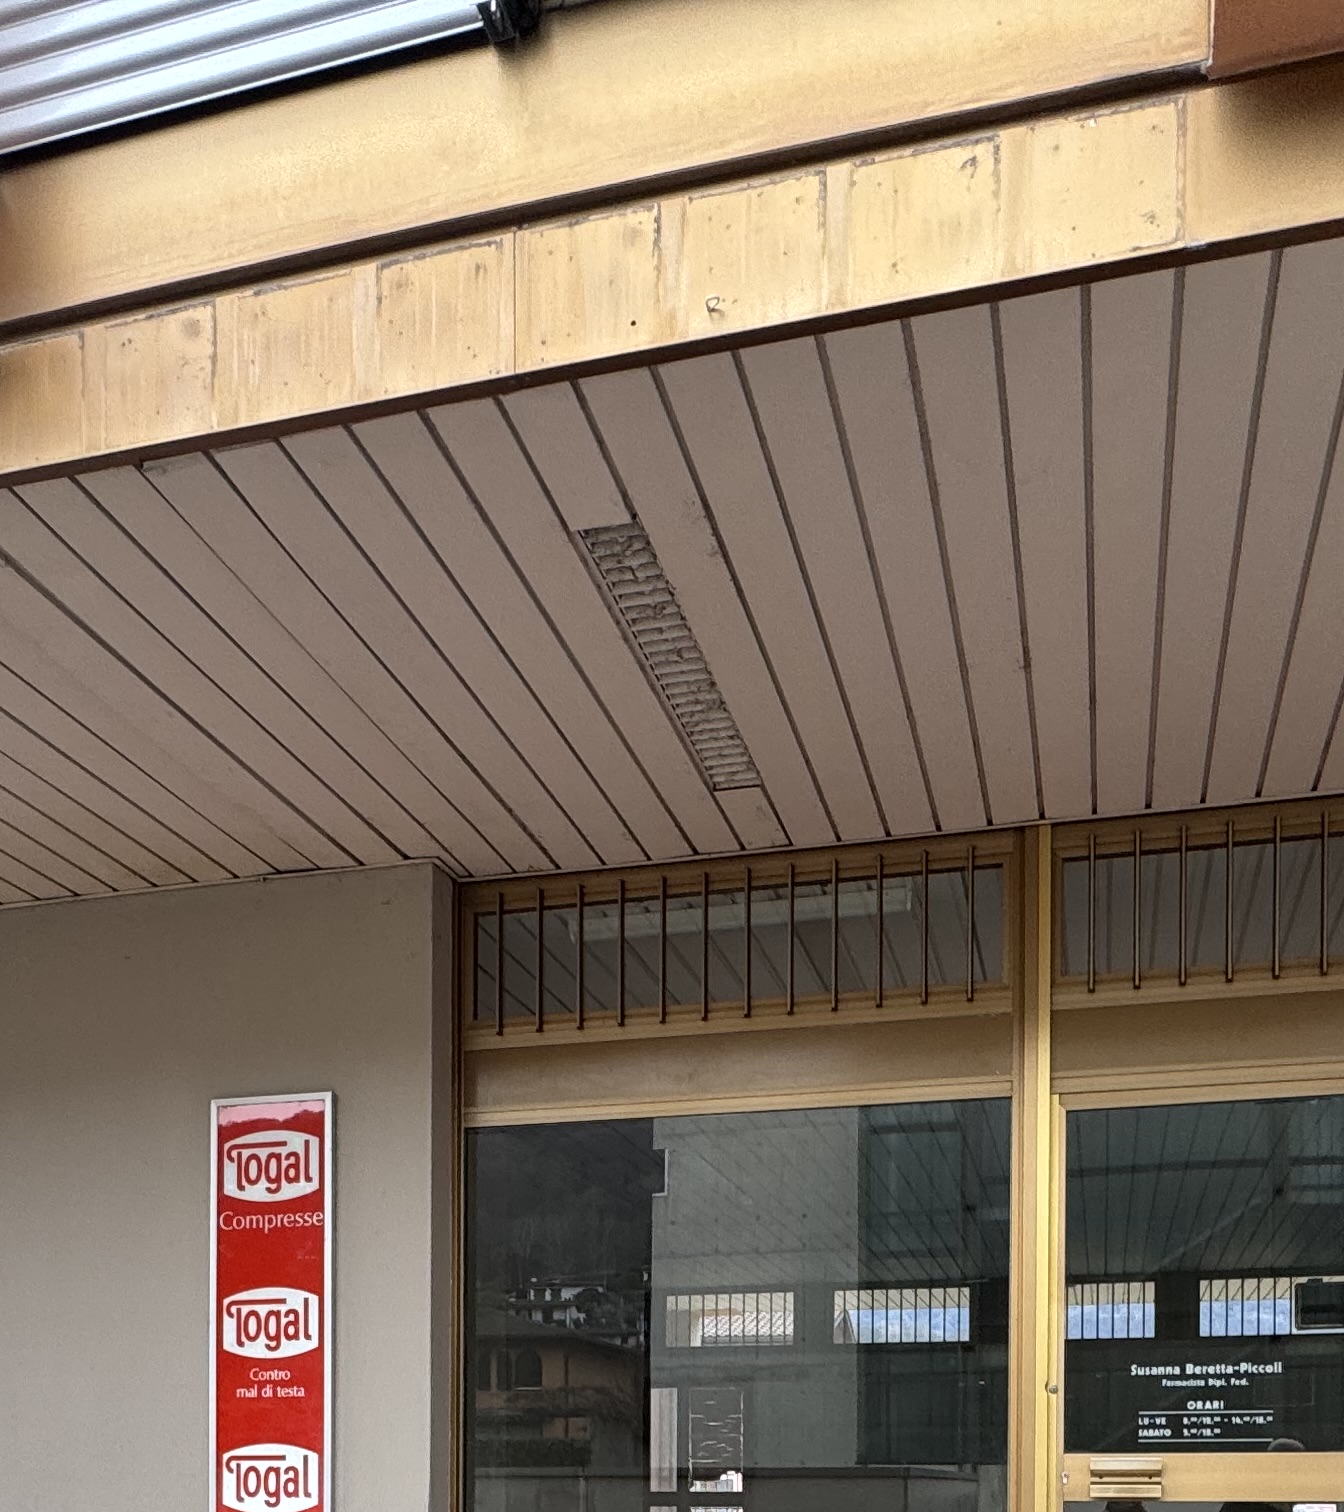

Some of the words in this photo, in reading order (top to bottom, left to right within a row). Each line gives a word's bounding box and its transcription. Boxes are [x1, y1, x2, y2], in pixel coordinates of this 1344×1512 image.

[227, 1139, 313, 1194] Togal
[219, 1211, 323, 1233] Compresse
[226, 1297, 312, 1352] Togal
[249, 1368, 291, 1381] Contro
[1130, 1363, 1181, 1376] Susanna
[1185, 1361, 1283, 1375] Beretta-Piccoli
[236, 1384, 258, 1398] mal
[261, 1384, 273, 1398] di
[277, 1385, 305, 1398] testa
[1186, 1400, 1224, 1410] ORARI
[1138, 1428, 1172, 1437] SABATO
[225, 1454, 312, 1508] Togal
